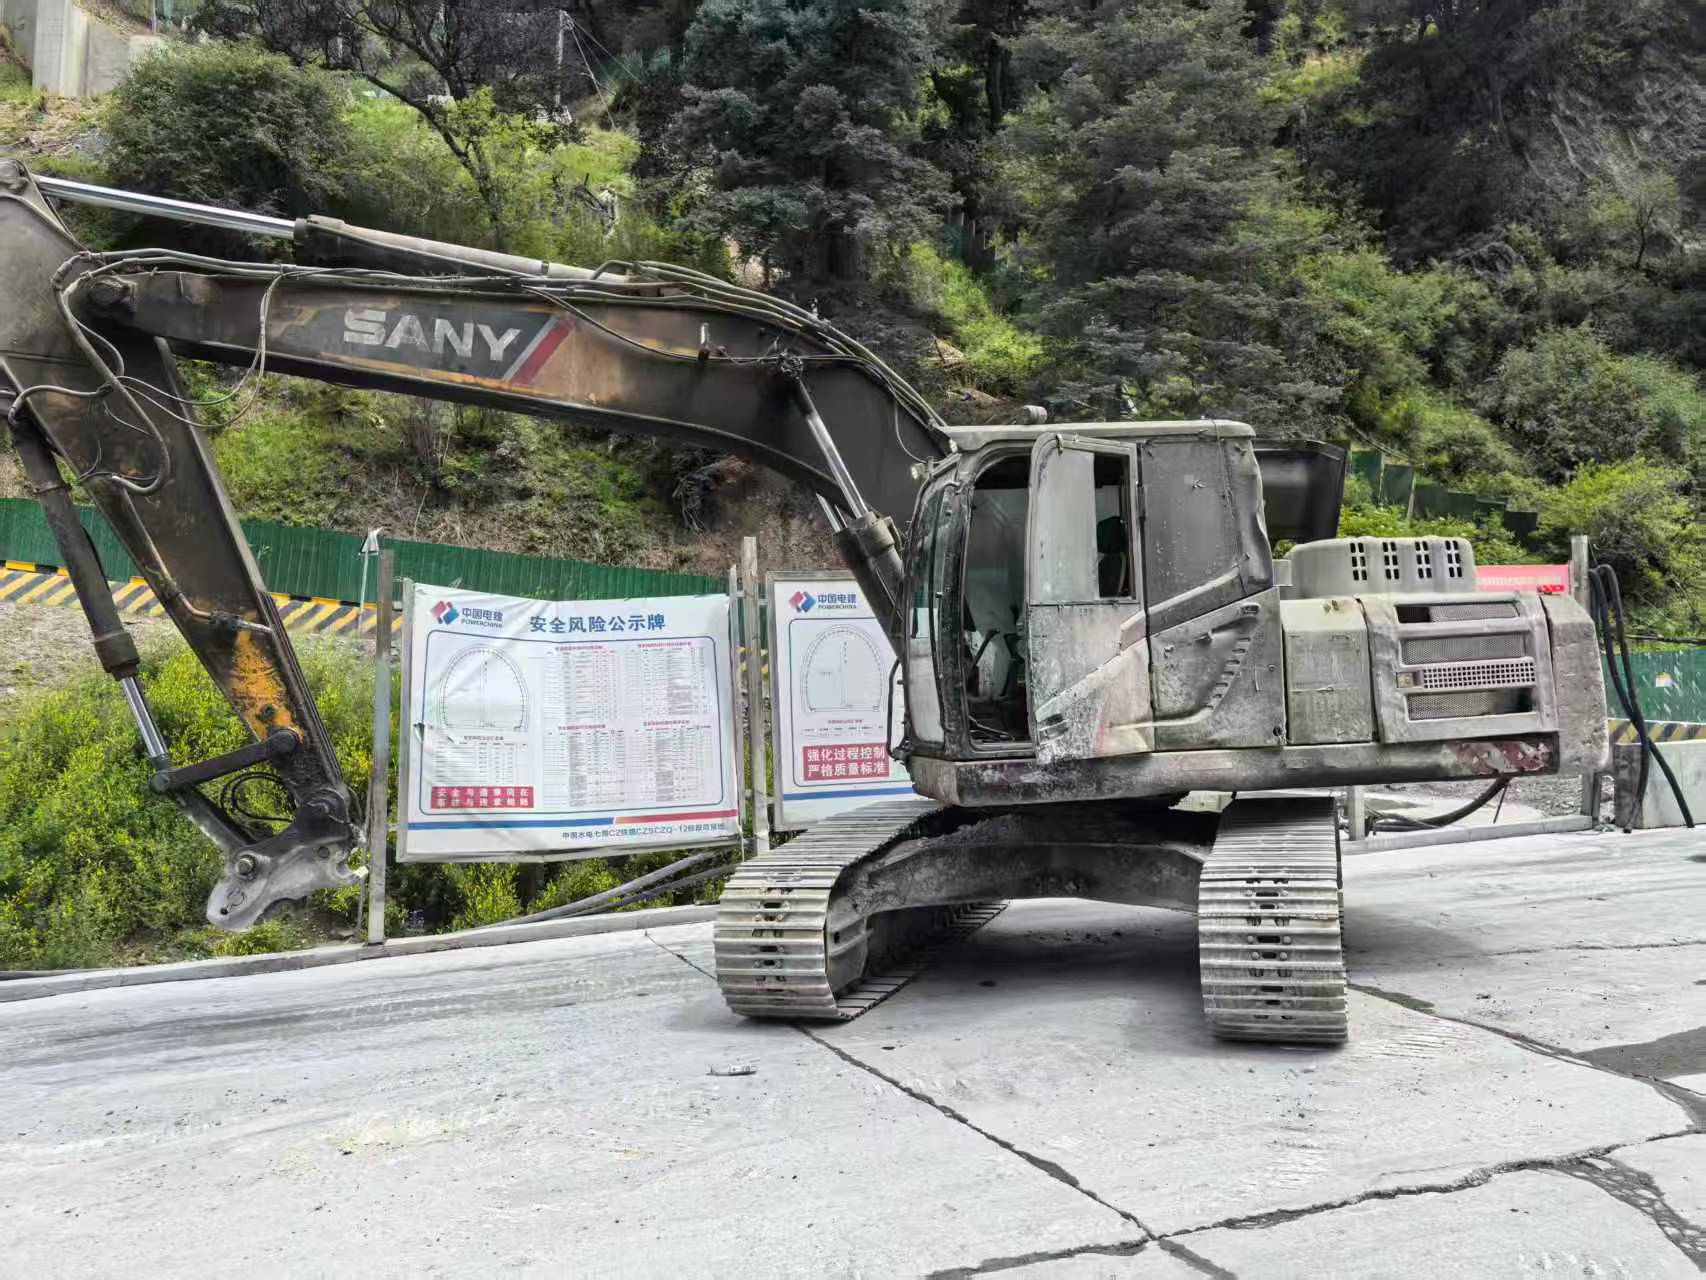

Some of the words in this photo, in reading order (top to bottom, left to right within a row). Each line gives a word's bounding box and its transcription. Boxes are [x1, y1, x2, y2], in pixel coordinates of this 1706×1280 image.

[343, 308, 521, 362] SANY
[817, 593, 857, 604] 中国电建
[461, 607, 503, 622] 中国电建
[529, 613, 667, 633] 安全风险公示牌
[807, 747, 886, 762] 强化过程控制
[807, 761, 887, 777] 严格质量标准
